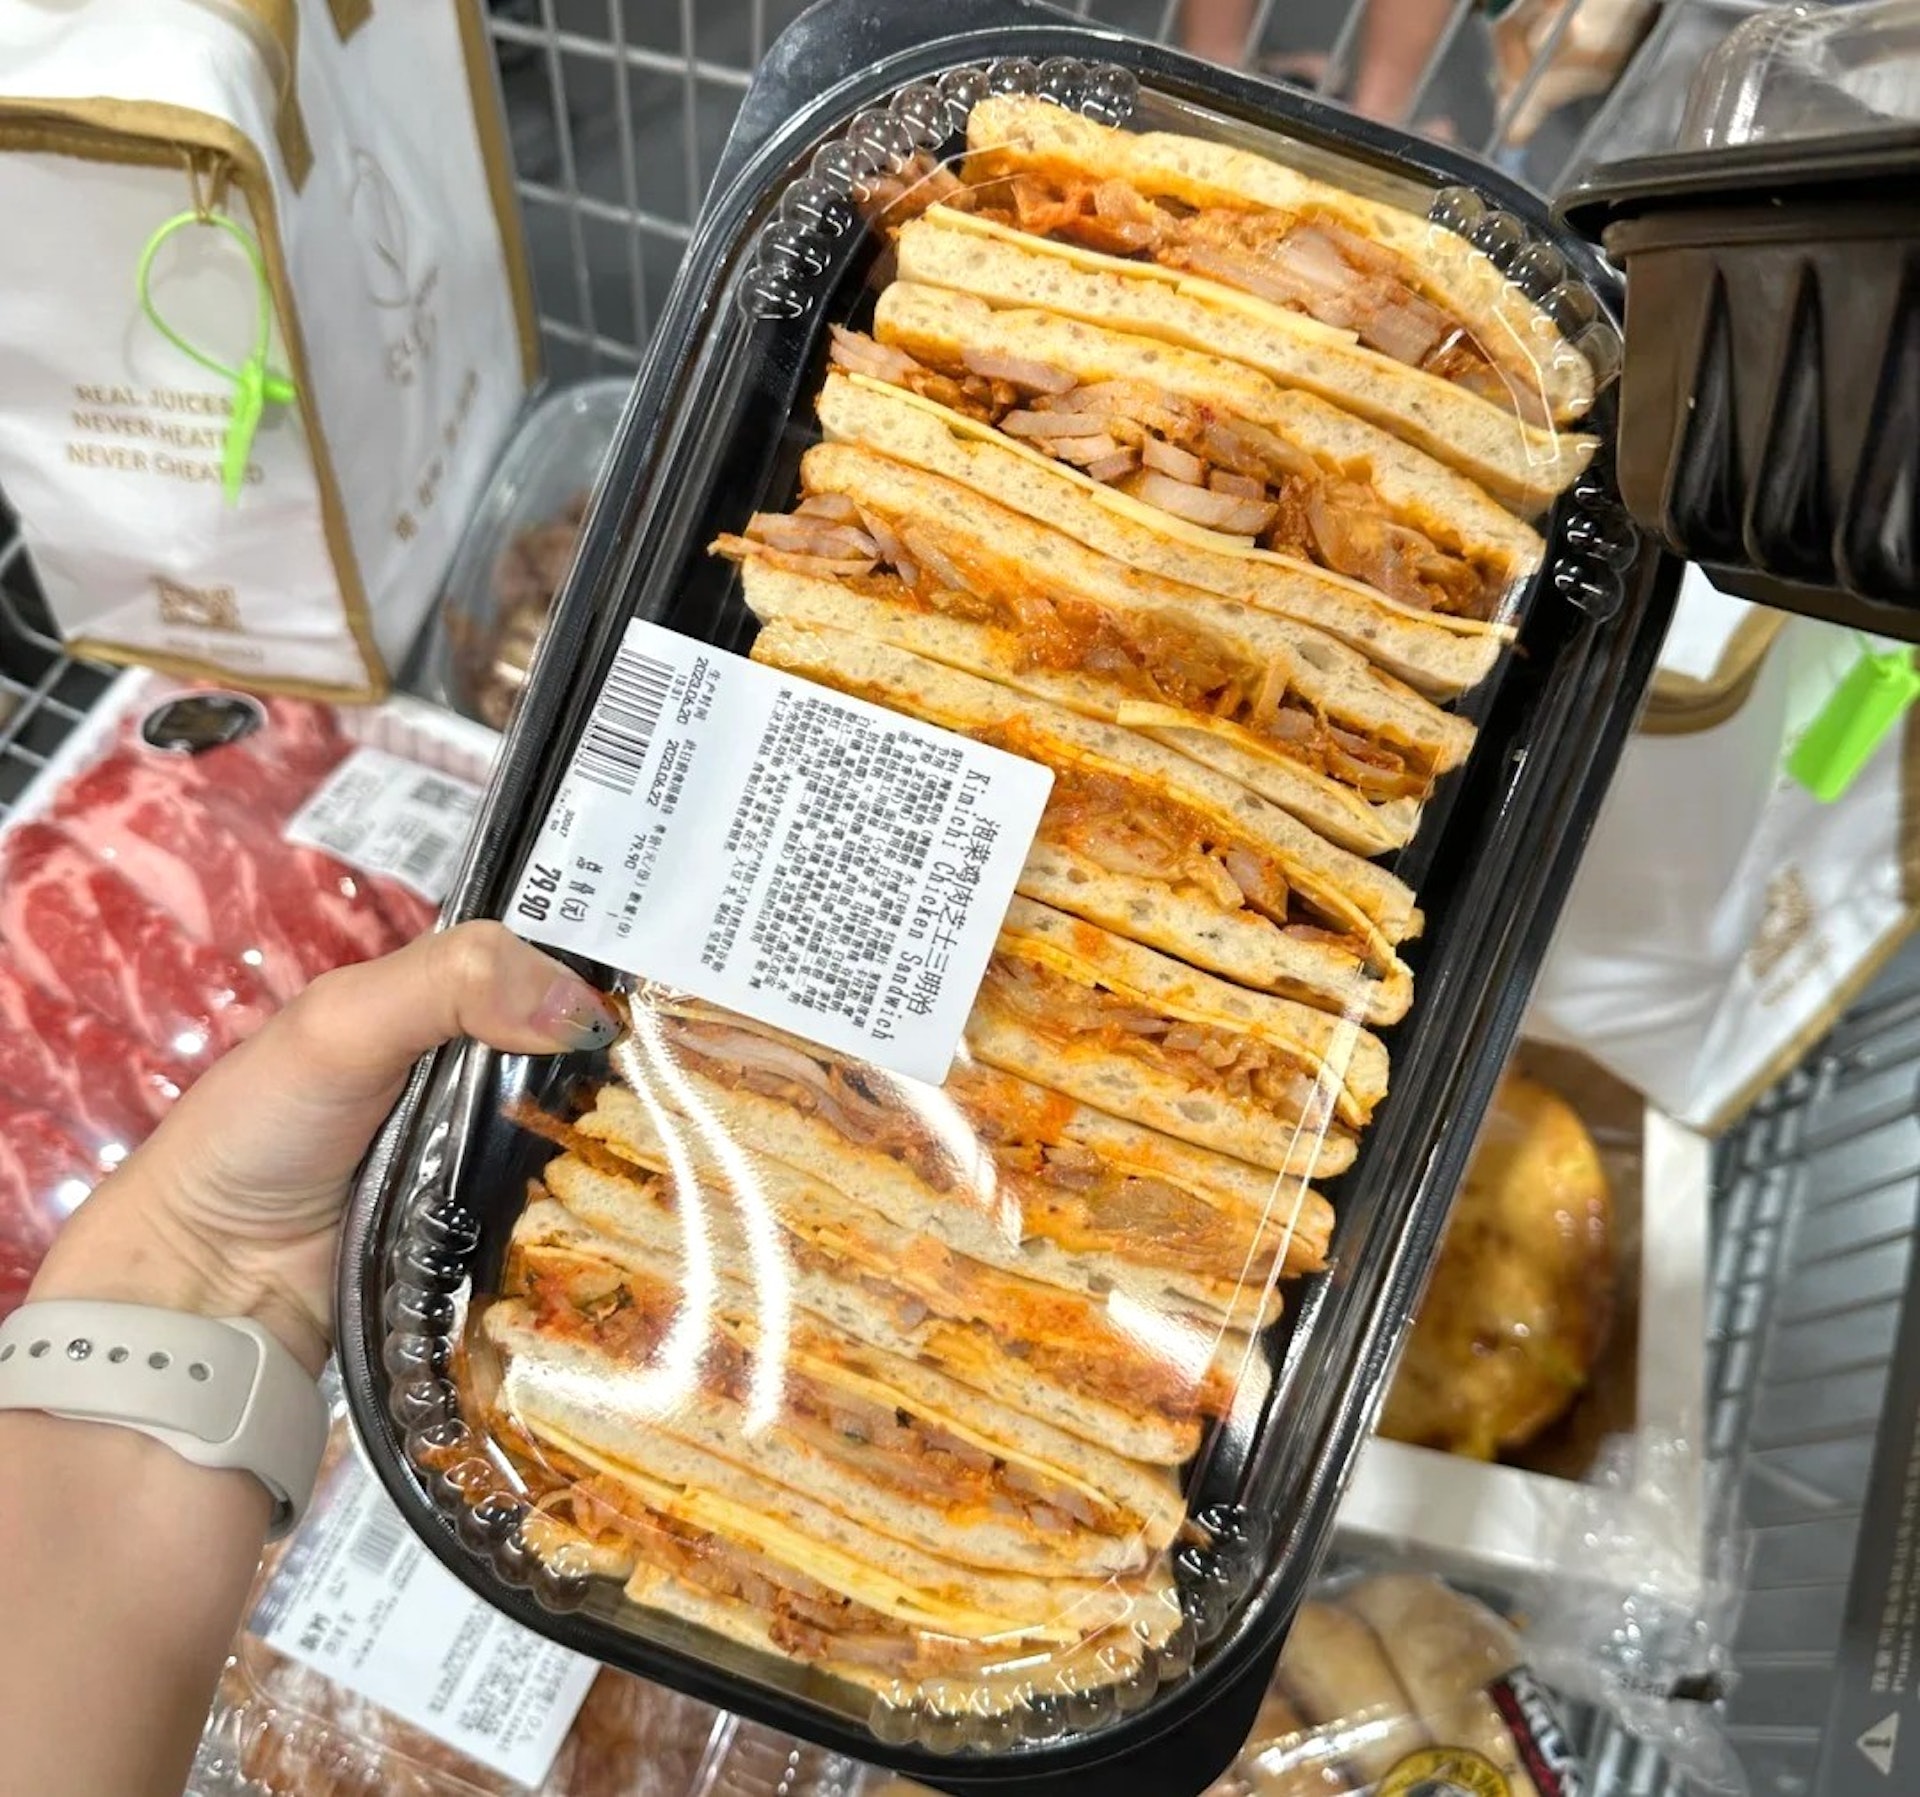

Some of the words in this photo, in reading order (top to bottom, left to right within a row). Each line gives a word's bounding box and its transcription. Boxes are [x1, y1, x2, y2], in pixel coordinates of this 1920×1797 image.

[74, 384, 140, 404] REAL
[72, 411, 154, 434] NEVER
[158, 424, 229, 448] HEAT
[67, 442, 148, 470] NEVER
[153, 453, 264, 483] CHEAD
[675, 656, 709, 725] 2023.06.20
[645, 738, 683, 807] 2023.06.22
[623, 833, 650, 870] 79.90
[516, 862, 562, 922] 79.90
[906, 816, 1001, 1015] 泡菜鸡肉芝士三明治
[907, 861, 957, 939] Chicken
[870, 950, 923, 1040] Sandwich
